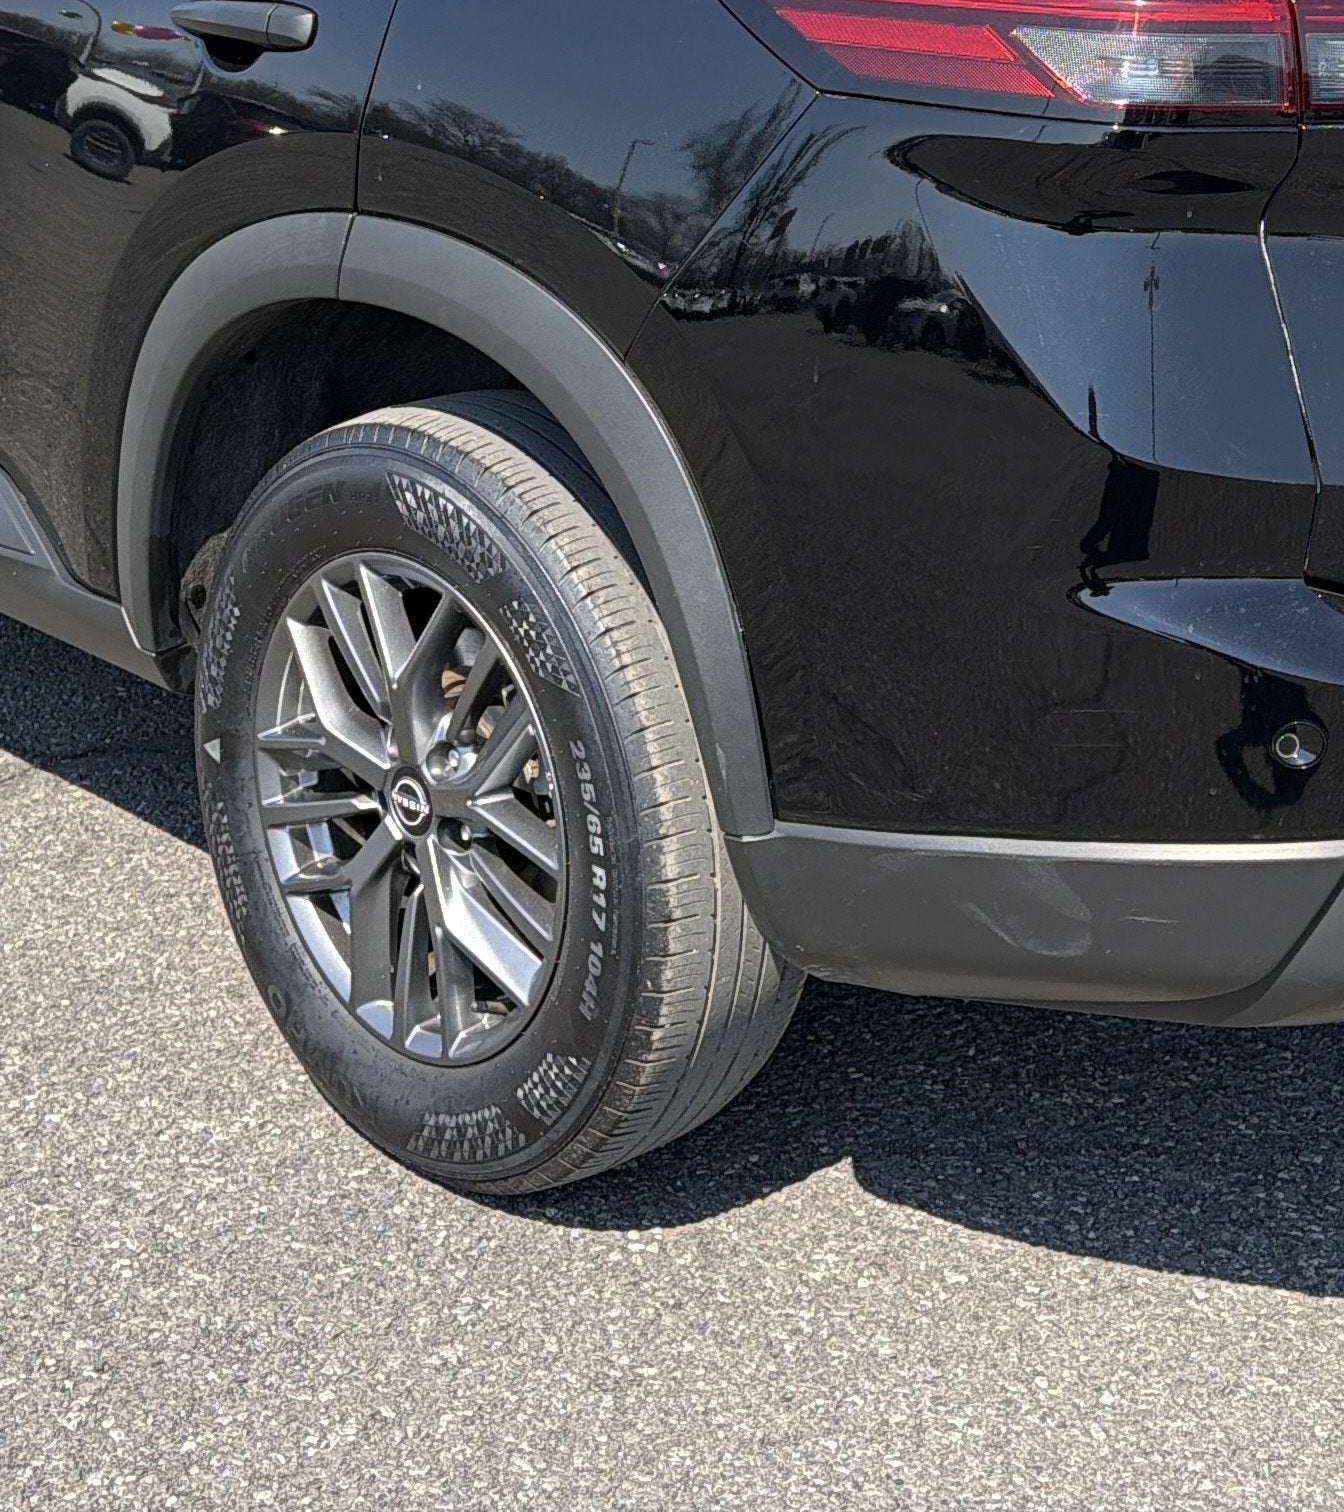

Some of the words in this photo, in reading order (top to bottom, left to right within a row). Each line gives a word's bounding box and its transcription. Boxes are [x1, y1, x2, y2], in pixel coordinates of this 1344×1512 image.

[569, 739, 605, 857] 235/65
[591, 864, 607, 933] R17
[578, 940, 605, 1022] 104H
